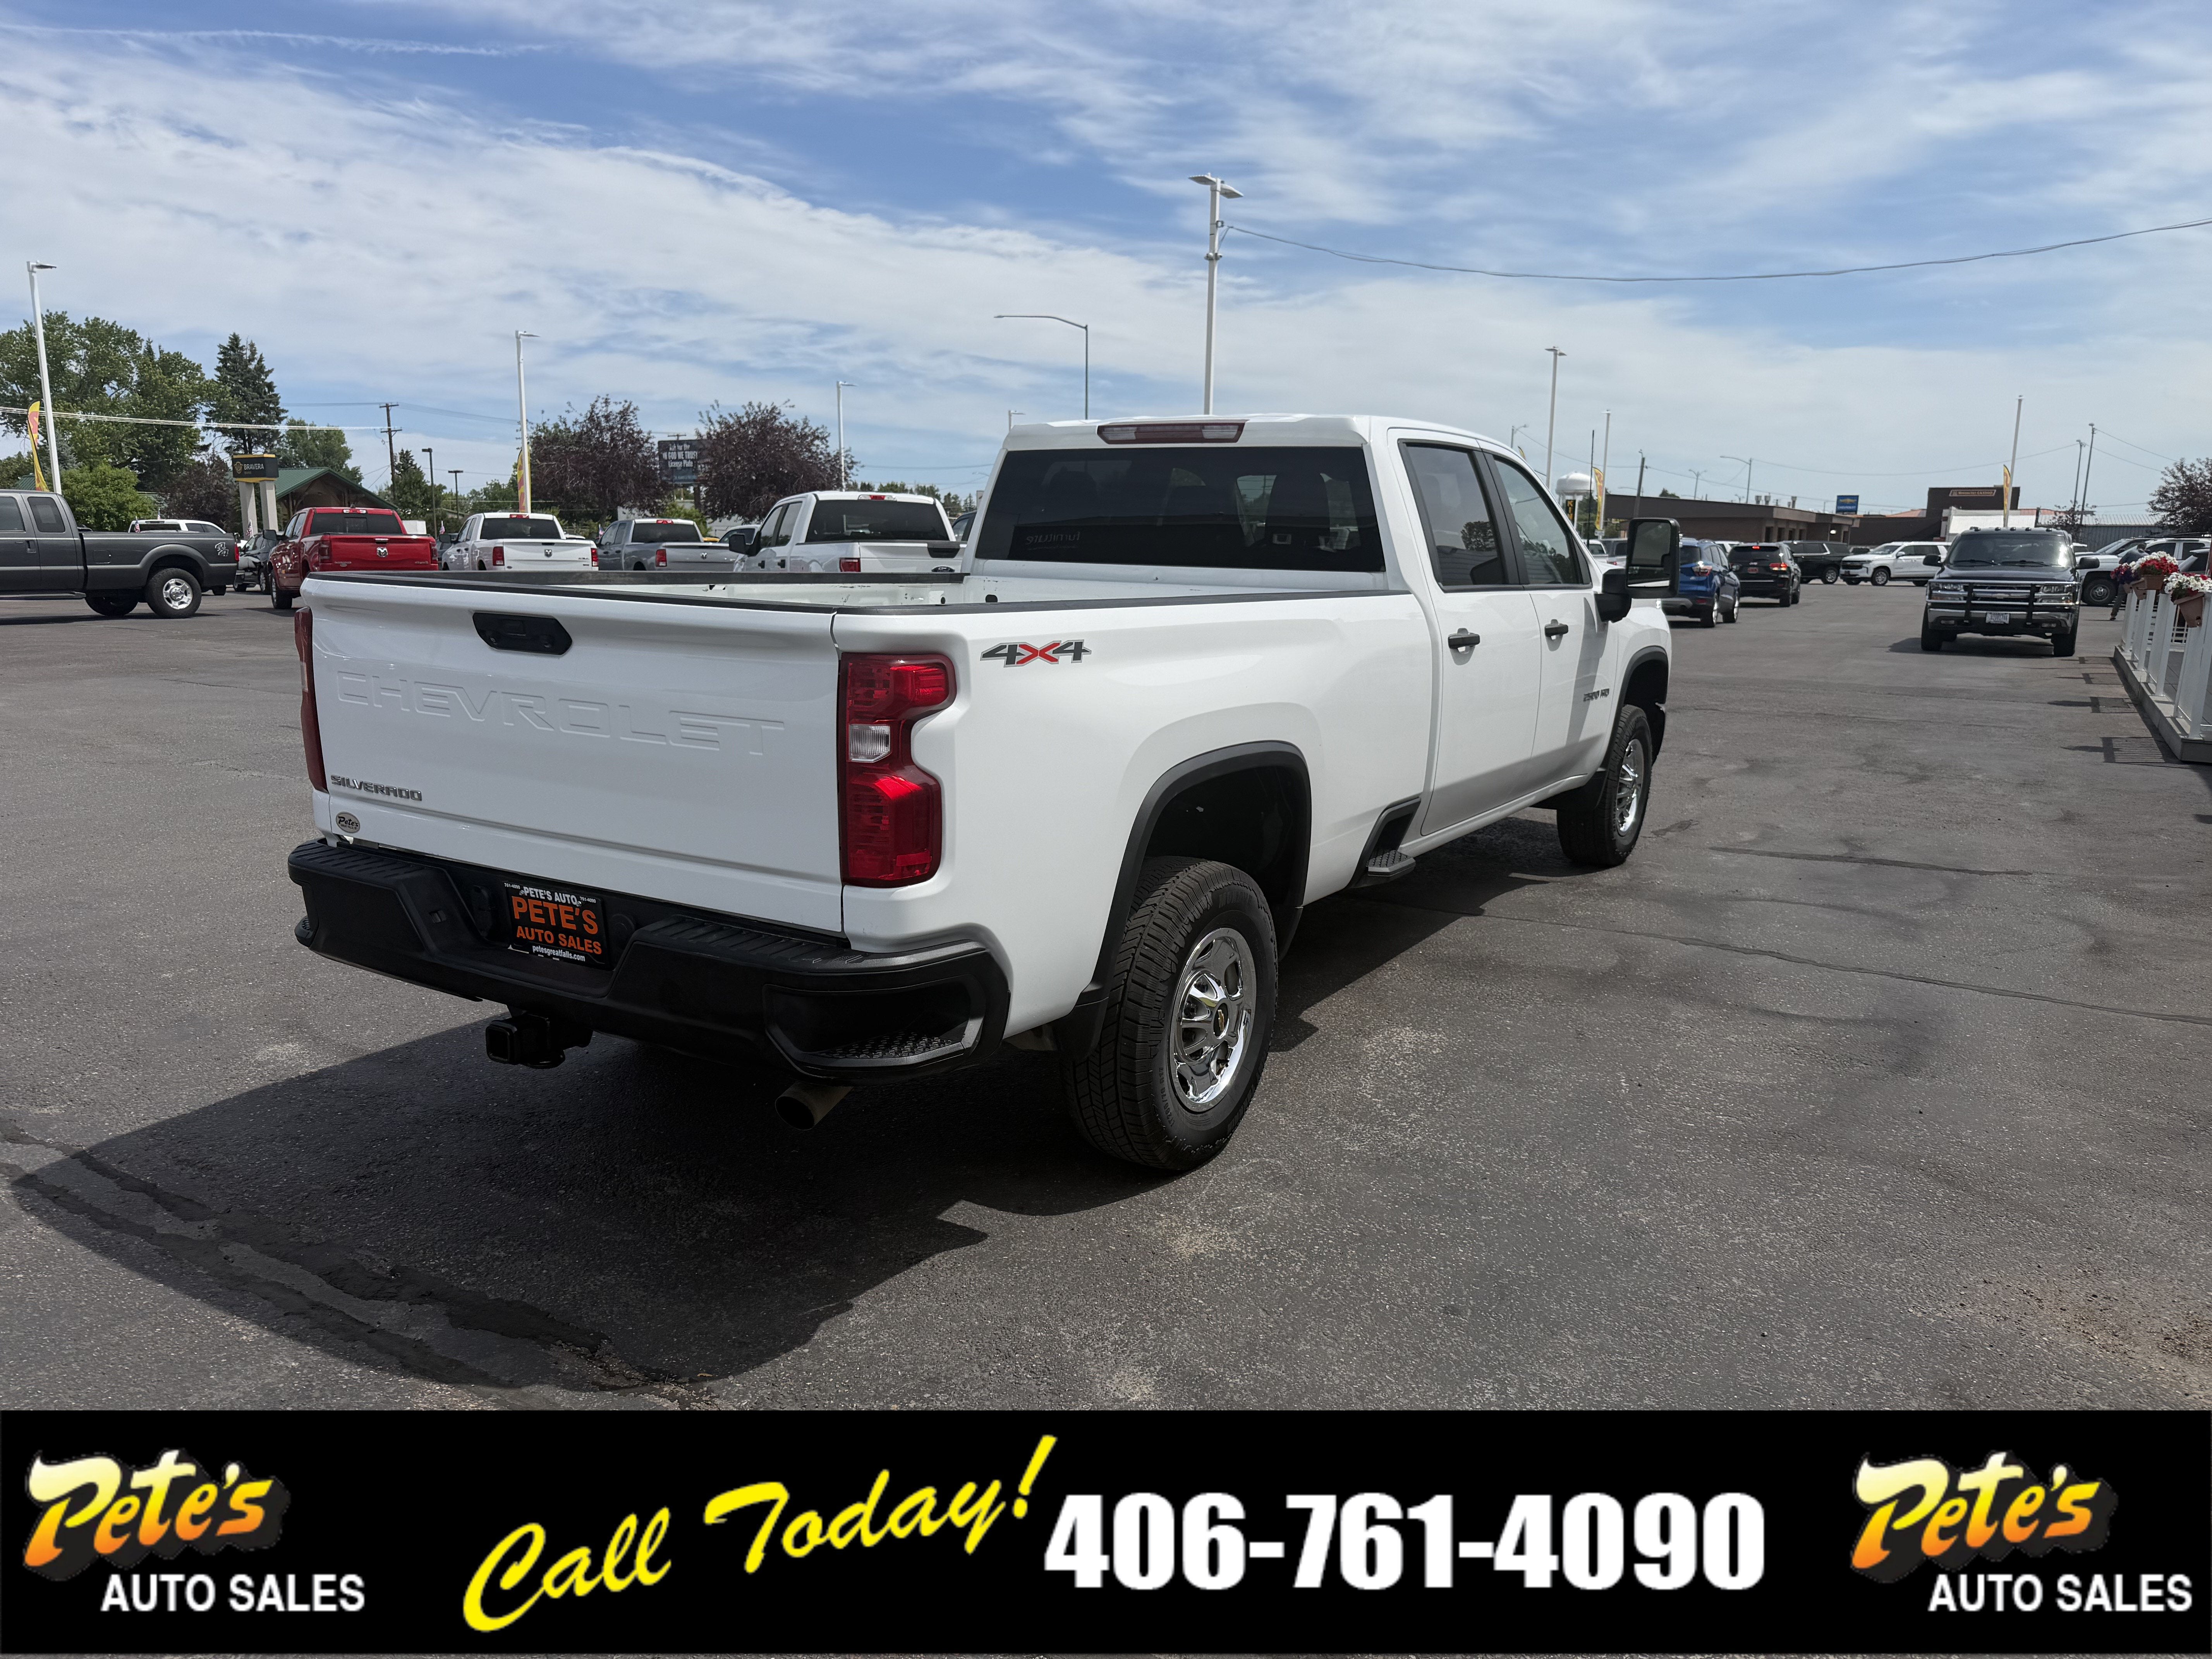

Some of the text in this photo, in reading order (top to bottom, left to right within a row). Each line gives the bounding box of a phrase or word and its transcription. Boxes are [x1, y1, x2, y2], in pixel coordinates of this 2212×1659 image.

[668, 451, 677, 460] GOD
[677, 451, 684, 459] WE
[668, 460, 682, 468] License
[337, 671, 785, 755] CHEVROLET
[331, 775, 422, 801] SILVERADO
[338, 816, 358, 827] Pete's
[523, 886, 577, 905] PETE'S AUTO
[512, 896, 598, 934] PETE'S
[517, 926, 602, 955] AUTO SALES
[532, 945, 585, 962] petesgreatfalls.com
